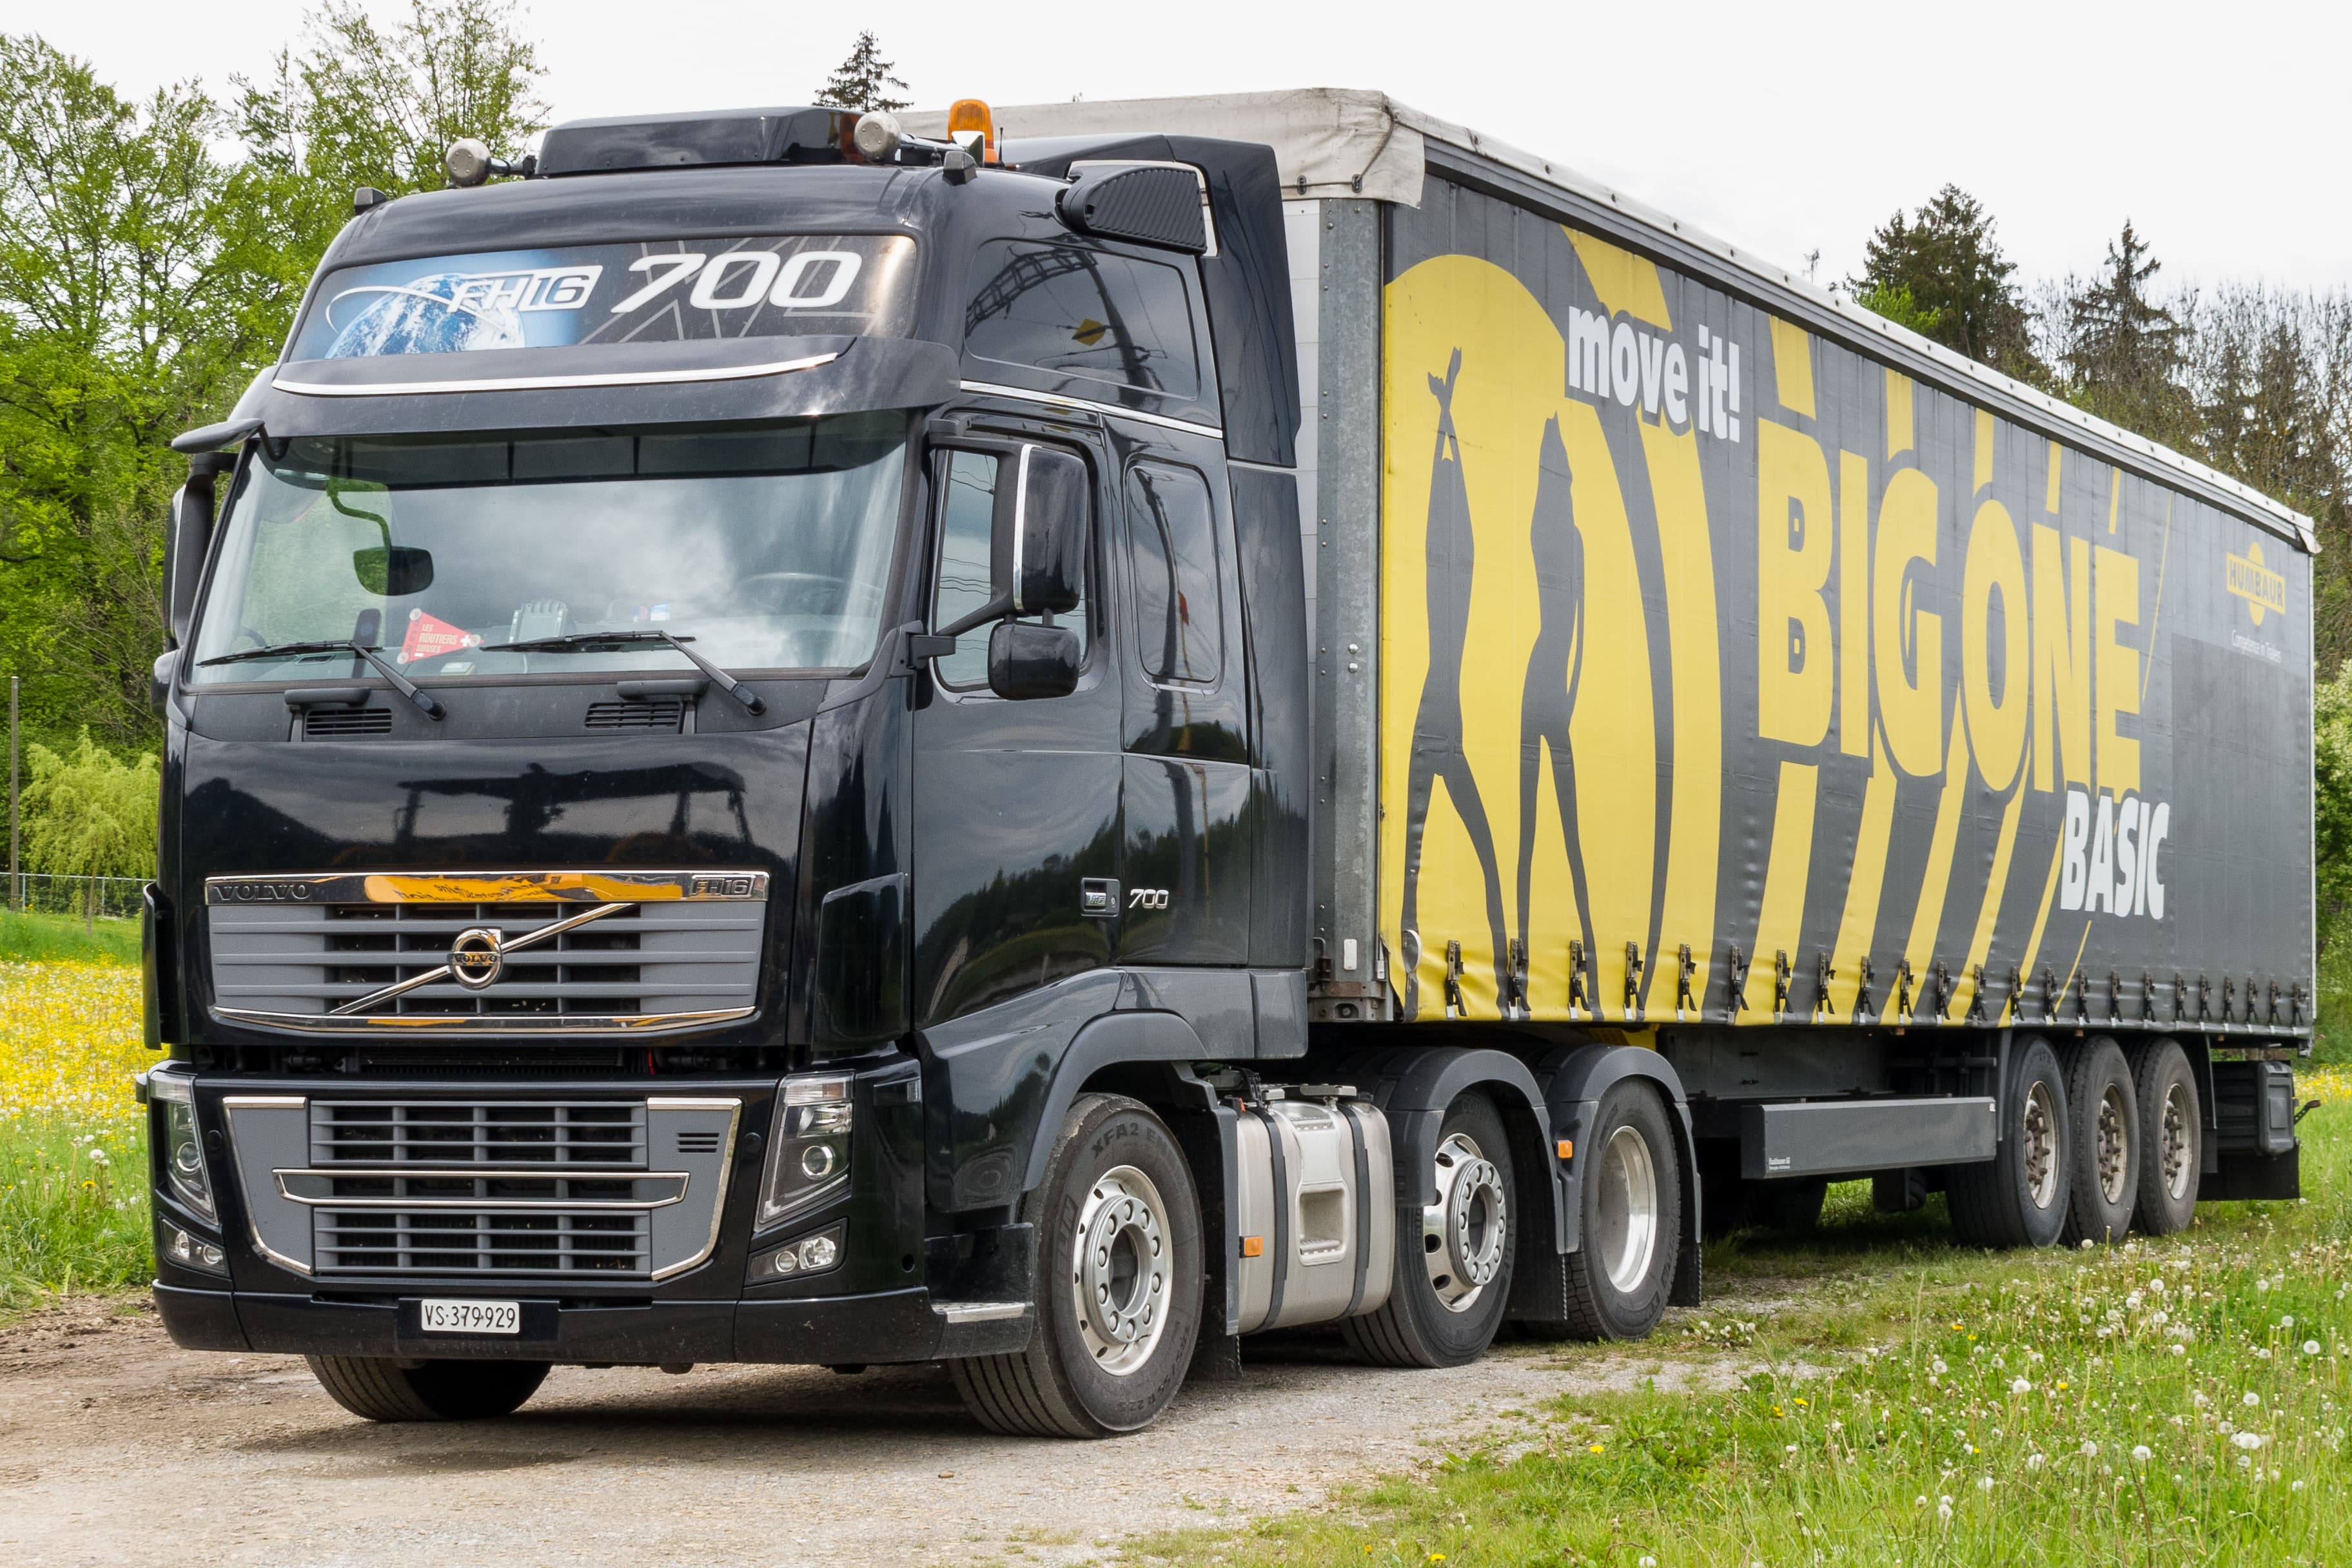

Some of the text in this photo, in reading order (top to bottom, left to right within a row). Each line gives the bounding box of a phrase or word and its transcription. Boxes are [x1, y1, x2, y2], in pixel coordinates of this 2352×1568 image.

[447, 250, 861, 313] FH16 700
[1568, 306, 1740, 444] move it!
[2228, 558, 2284, 609] HUMBAUR
[1758, 416, 2141, 801] BIG ONE
[422, 623, 434, 632] LES
[418, 632, 458, 645] ROUTIERS
[2060, 789, 2170, 920] BASIC
[213, 883, 311, 901] VOLVO
[691, 877, 750, 897] FH16
[1128, 888, 1170, 909] 700
[454, 954, 498, 963] VOLVO
